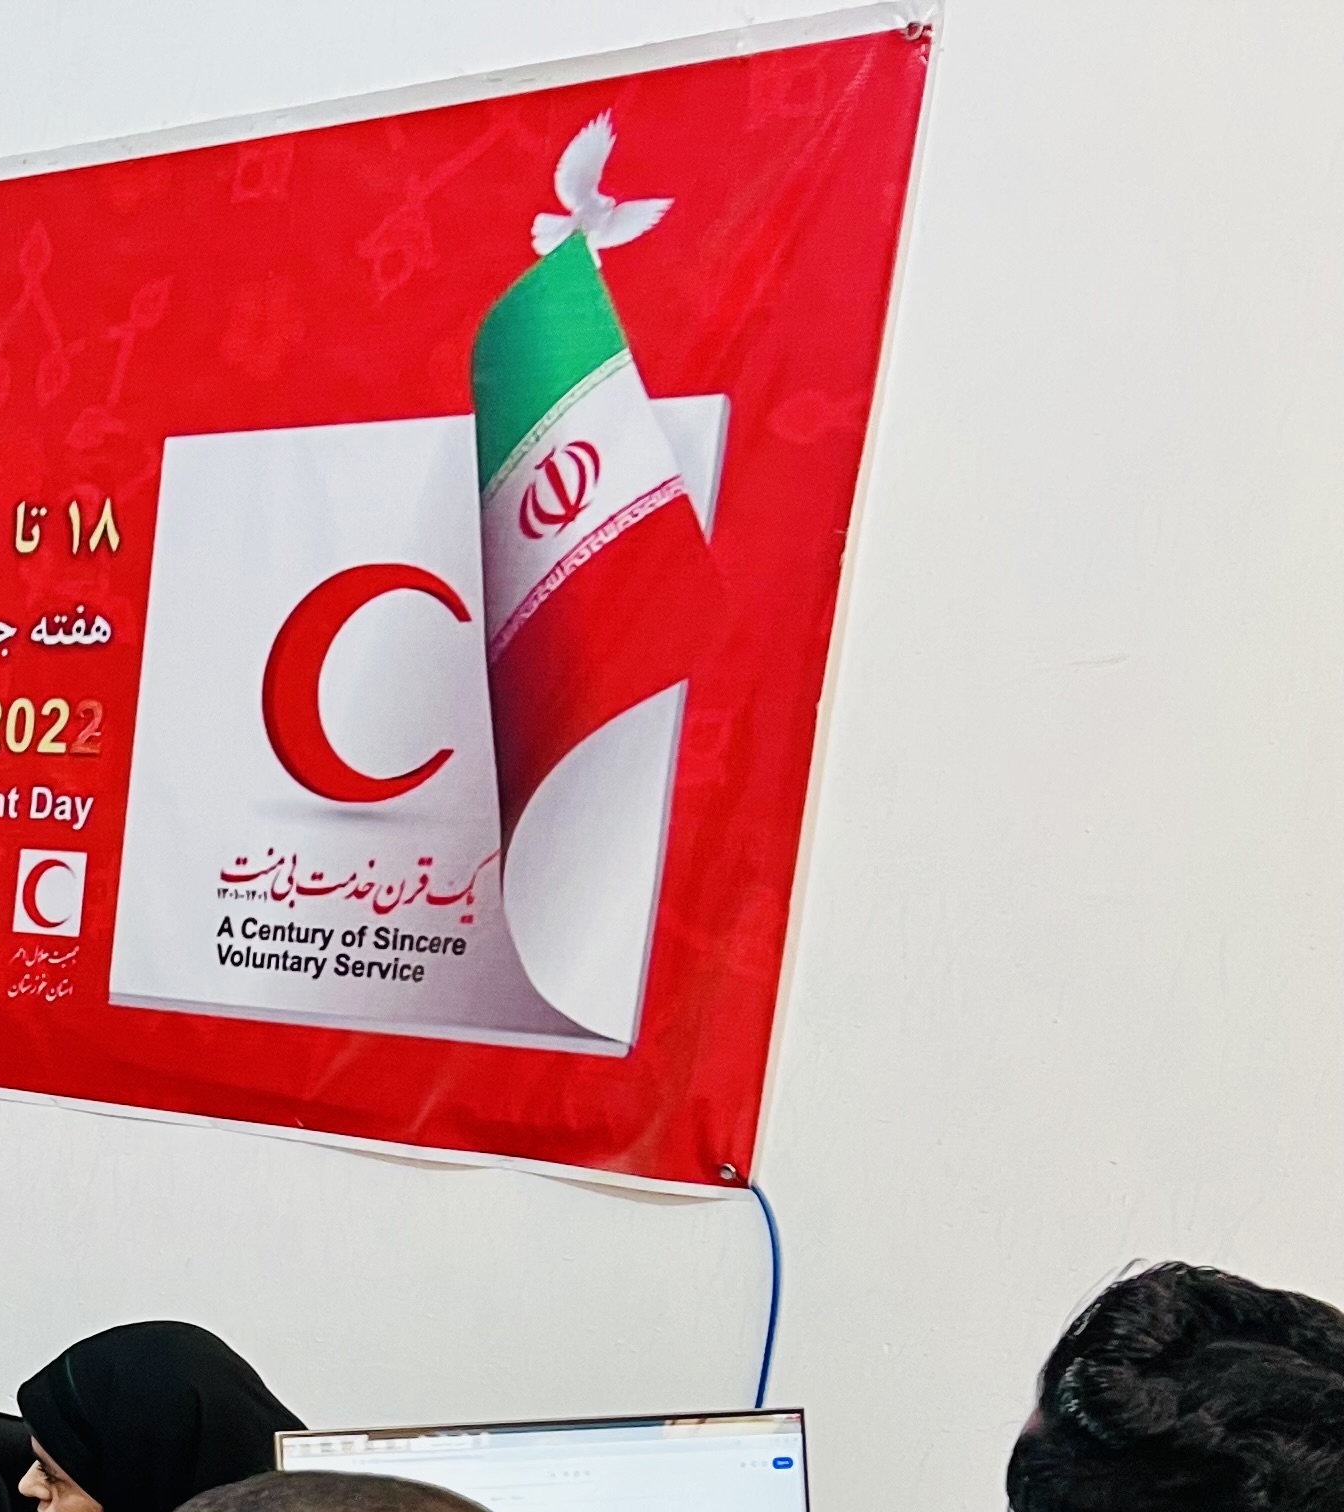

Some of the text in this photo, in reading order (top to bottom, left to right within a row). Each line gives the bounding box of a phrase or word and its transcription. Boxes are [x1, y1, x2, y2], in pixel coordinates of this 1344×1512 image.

[15, 501, 48, 554] تا
[68, 497, 120, 554] ۱۸
[30, 605, 112, 646] هفته
[29, 786, 94, 830] Day
[295, 859, 376, 900] خدمت
[372, 856, 433, 915] قرن
[216, 916, 467, 956] A Century of Sincere
[216, 944, 426, 983] Voluntary Service
